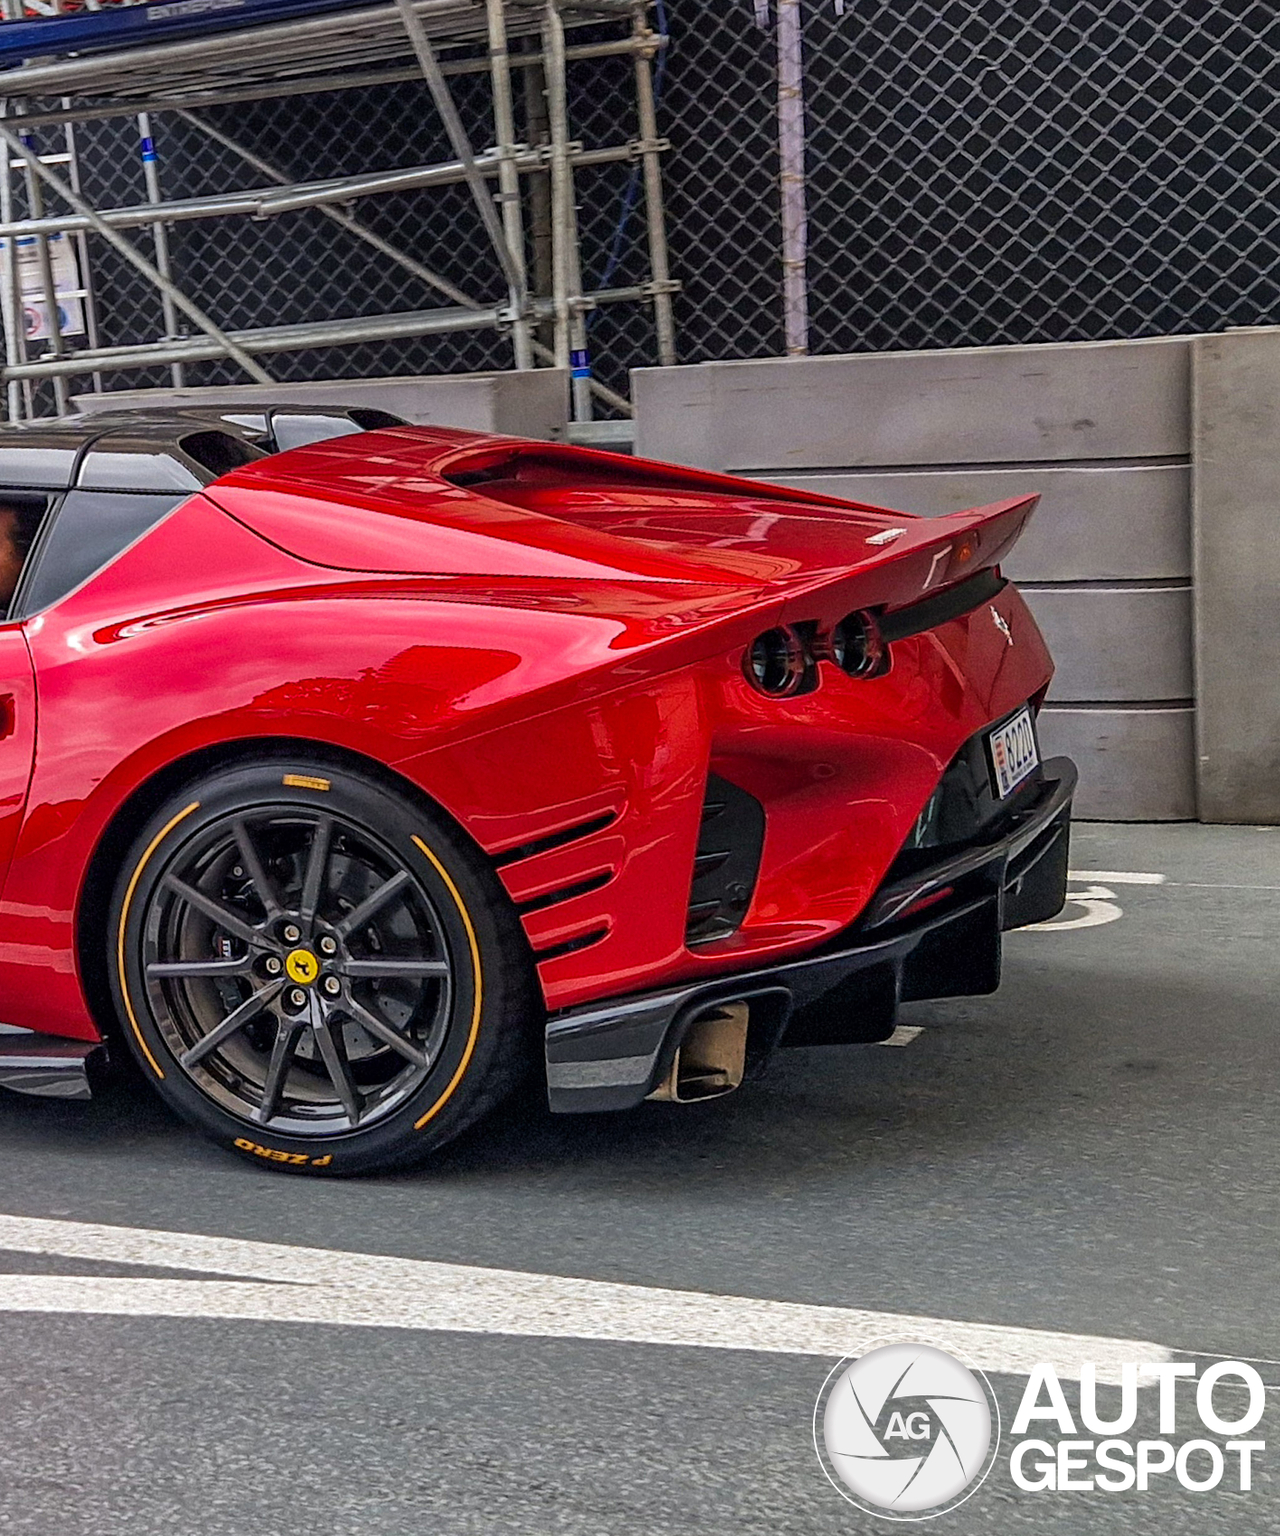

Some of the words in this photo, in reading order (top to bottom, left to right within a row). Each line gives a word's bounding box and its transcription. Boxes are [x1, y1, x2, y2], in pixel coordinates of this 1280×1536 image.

[1006, 717, 1032, 772] 8220
[233, 1137, 310, 1165] ZERO
[311, 1153, 333, 1166] P
